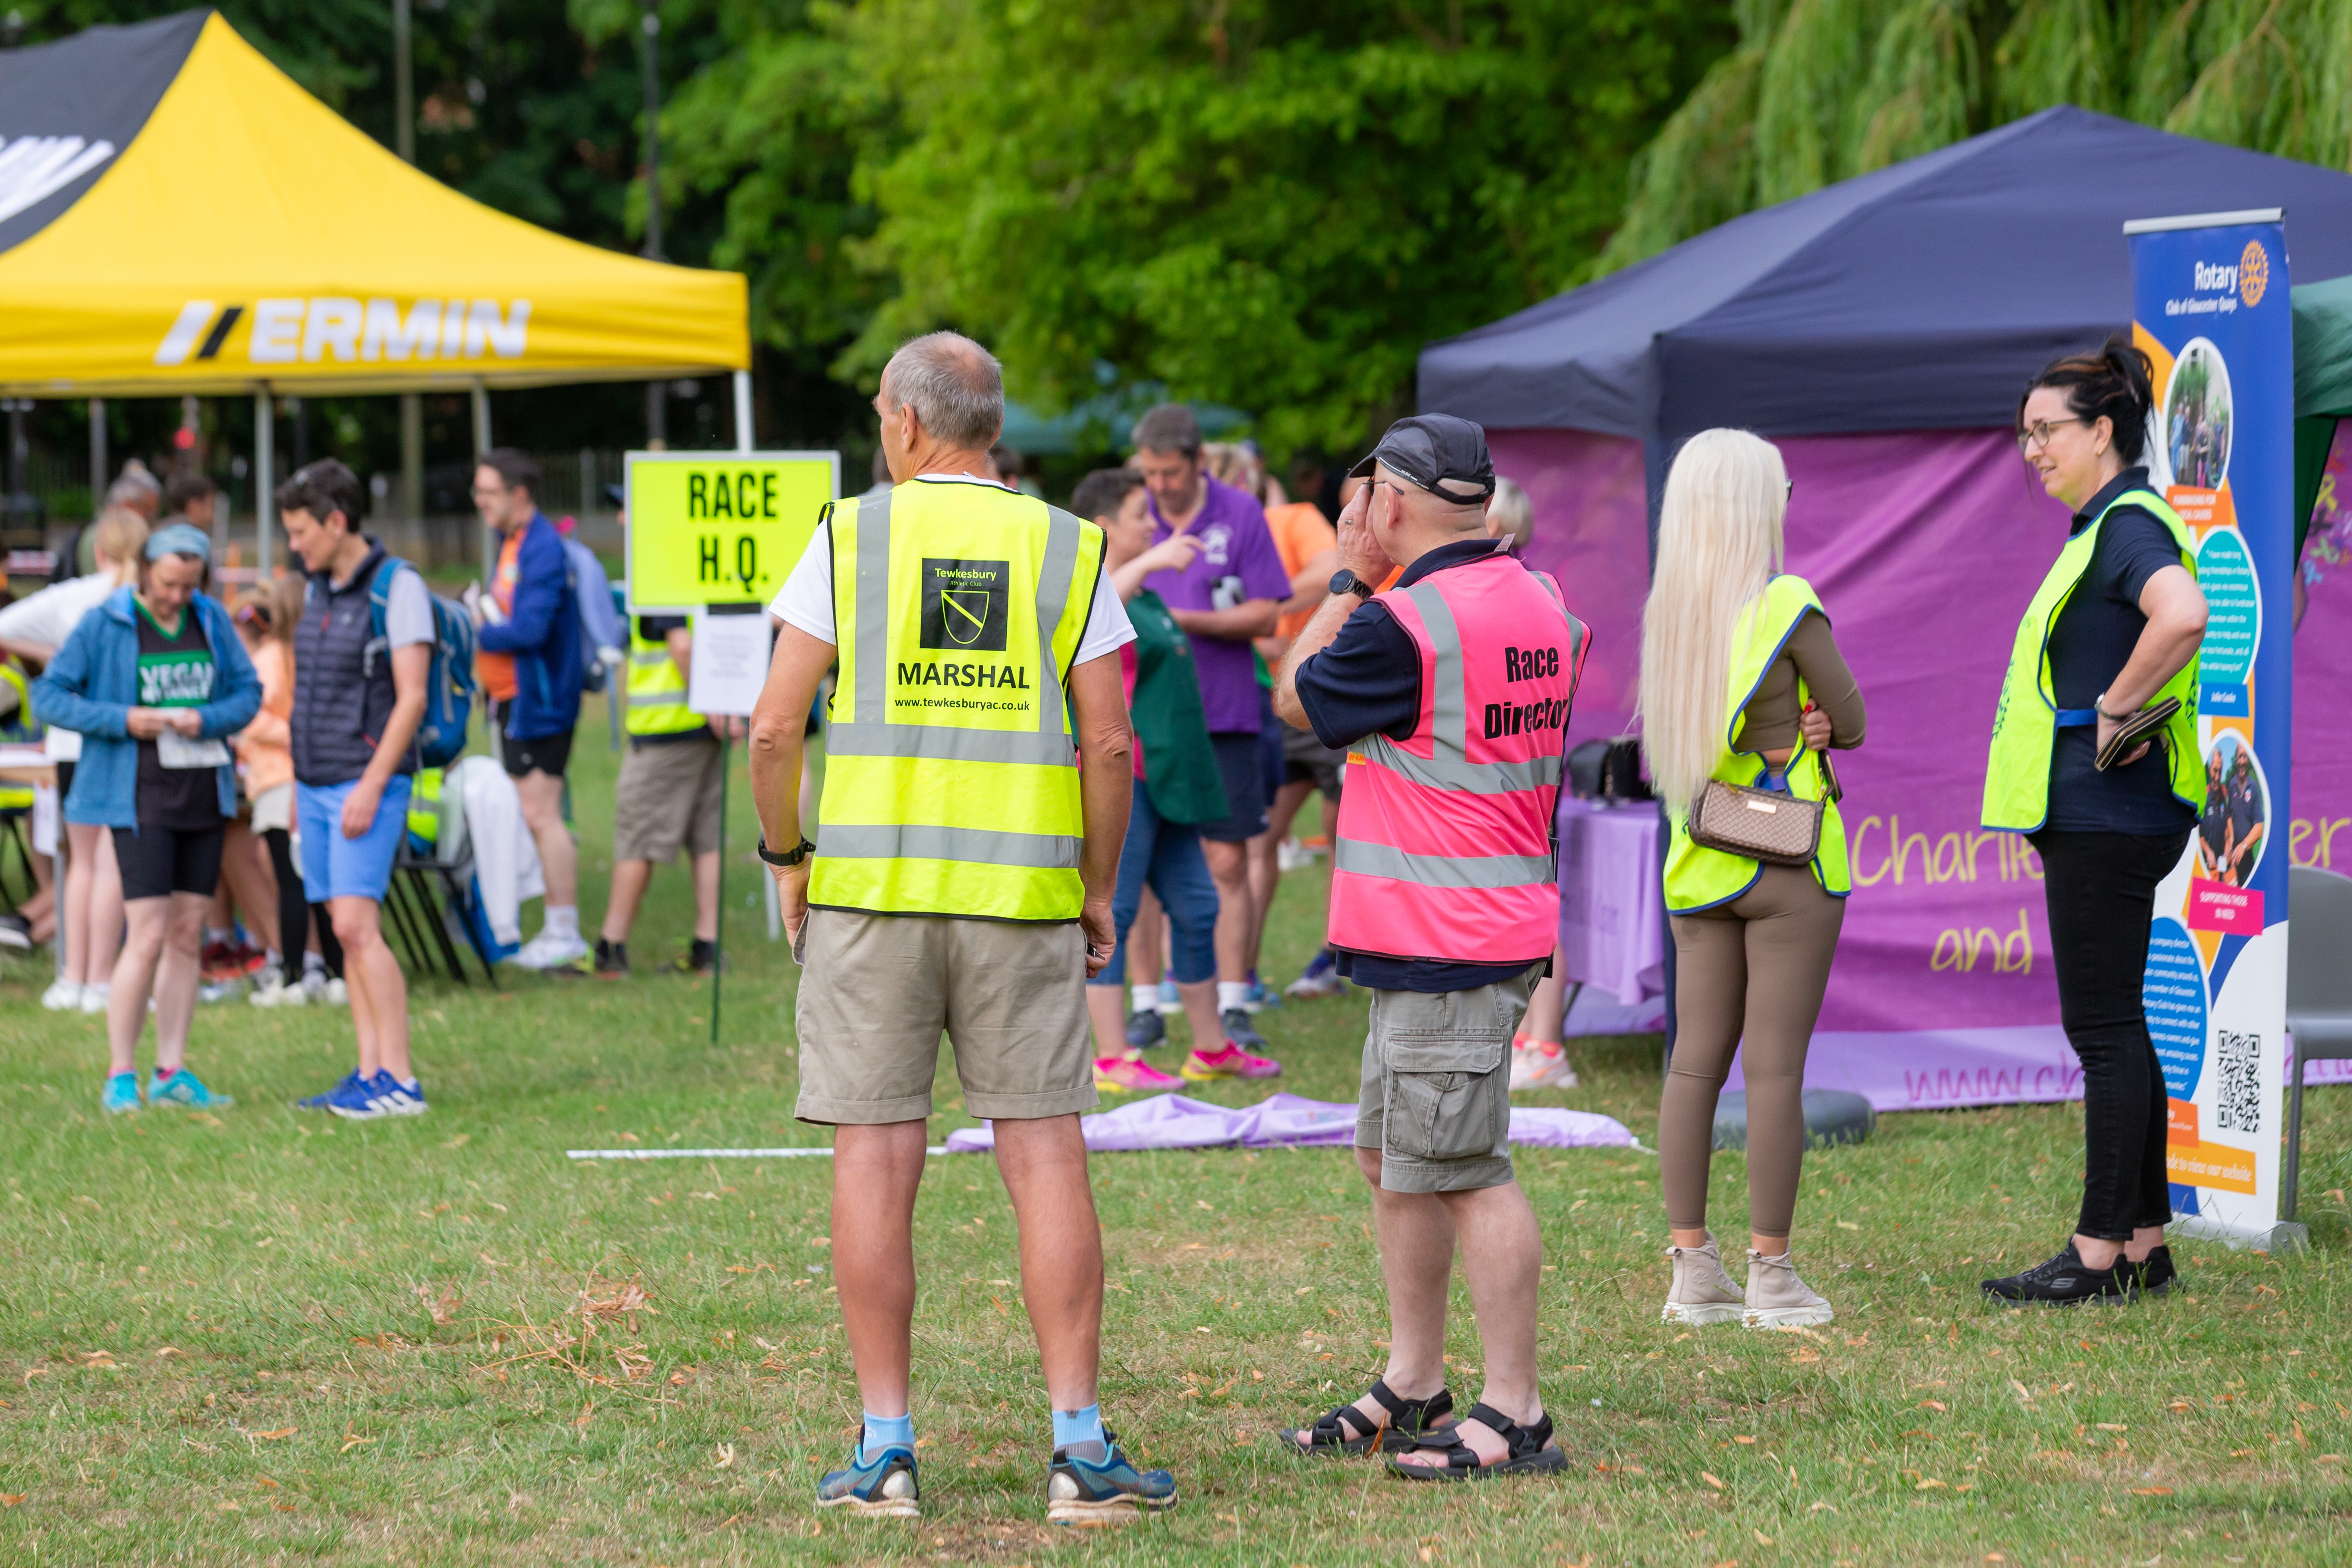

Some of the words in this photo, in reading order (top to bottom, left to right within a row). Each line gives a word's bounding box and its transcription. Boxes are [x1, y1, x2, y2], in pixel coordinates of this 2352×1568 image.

[2194, 260, 2238, 295] Rotary
[249, 297, 531, 363] ERMIN
[688, 473, 777, 518] RACE
[700, 537, 769, 593] H.Q.
[935, 568, 997, 581] Tewkesbury
[898, 663, 1030, 689] MARSHAL
[1505, 646, 1559, 683] Race
[895, 697, 1030, 711] www.tewkesburyac.co.uk
[1484, 697, 1569, 740] Director
[1930, 907, 2034, 975] and
[2178, 1156, 2188, 1171] to
[2187, 1156, 2207, 1174] view
[2206, 1164, 2222, 1176] our
[2222, 1162, 2252, 1182] website
